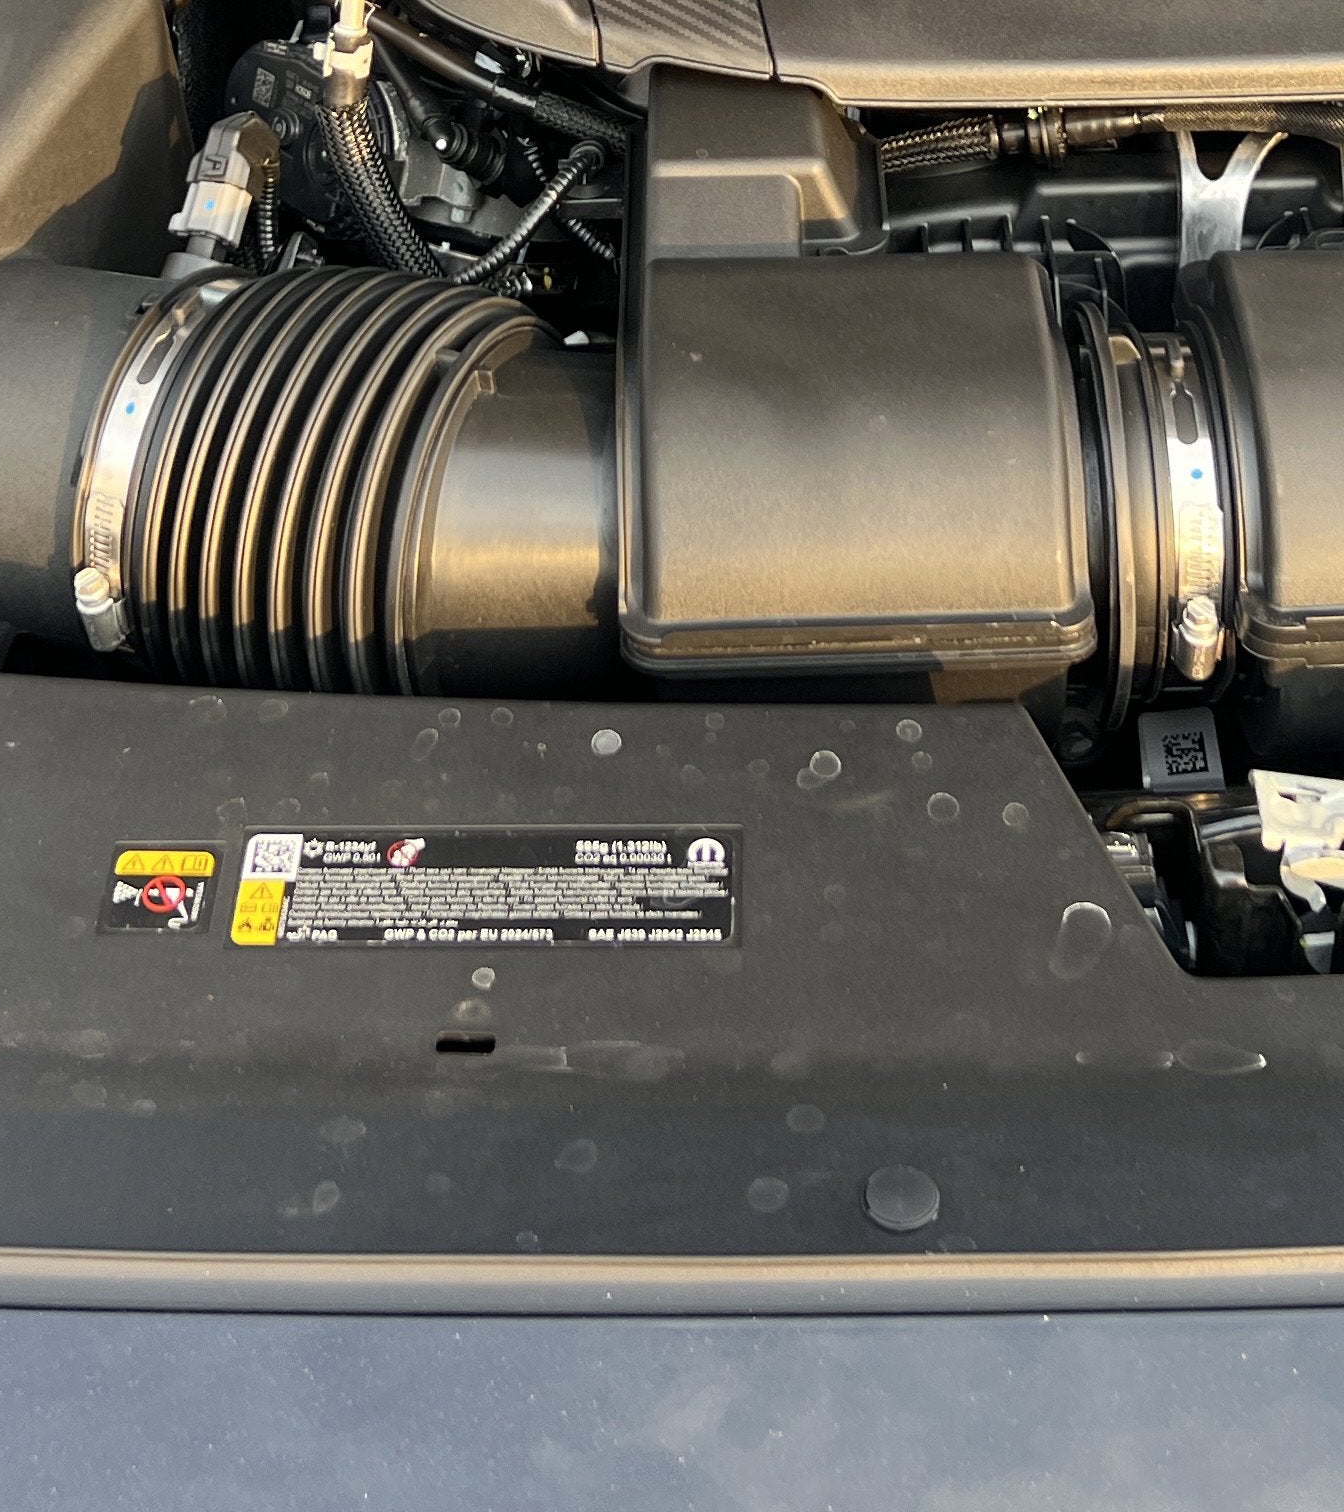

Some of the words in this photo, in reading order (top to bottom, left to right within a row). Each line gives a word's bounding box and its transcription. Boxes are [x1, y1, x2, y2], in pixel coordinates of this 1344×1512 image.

[322, 852, 352, 865] GWP
[383, 928, 415, 941] GWP
[479, 928, 499, 941] EU
[587, 928, 615, 942] SAE
